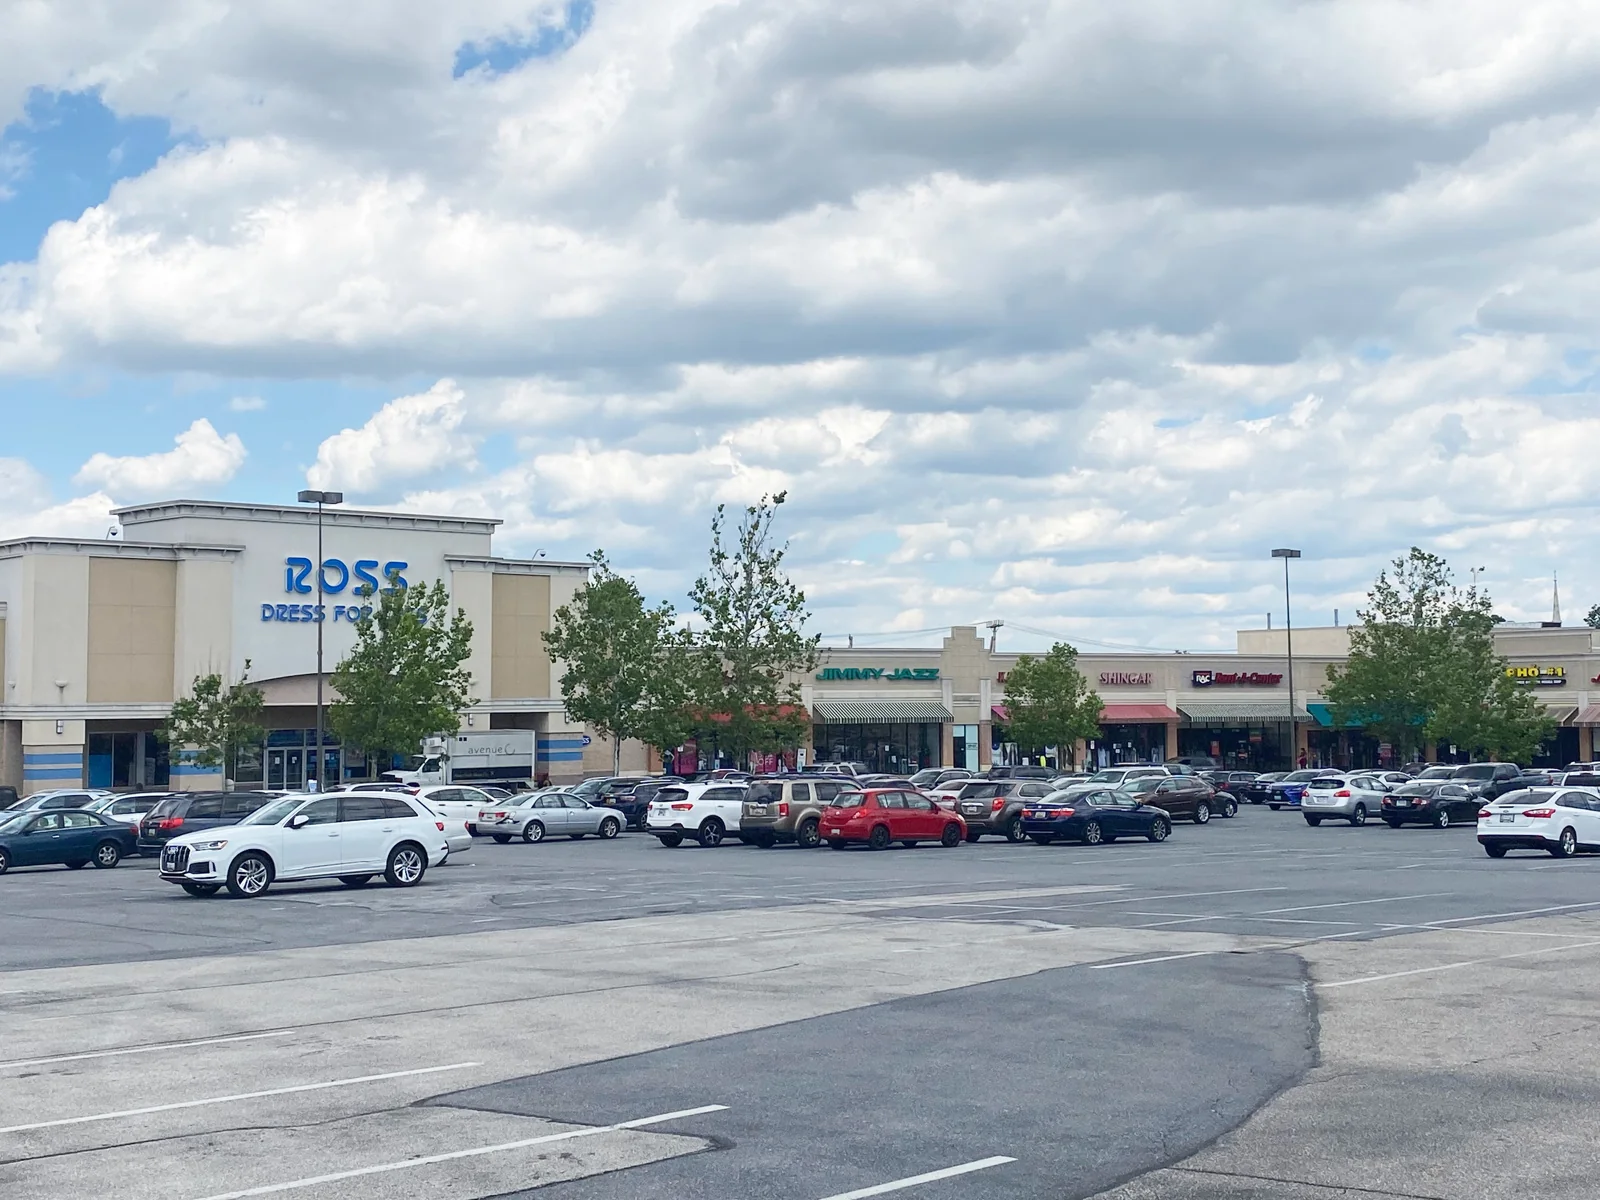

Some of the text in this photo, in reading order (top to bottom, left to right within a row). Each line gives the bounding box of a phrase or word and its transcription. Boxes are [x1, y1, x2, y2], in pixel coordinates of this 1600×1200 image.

[285, 556, 409, 596] ROSS
[261, 603, 326, 622] DRESS
[815, 667, 940, 681] JIMMY JAZZ
[468, 746, 503, 755] avenue
